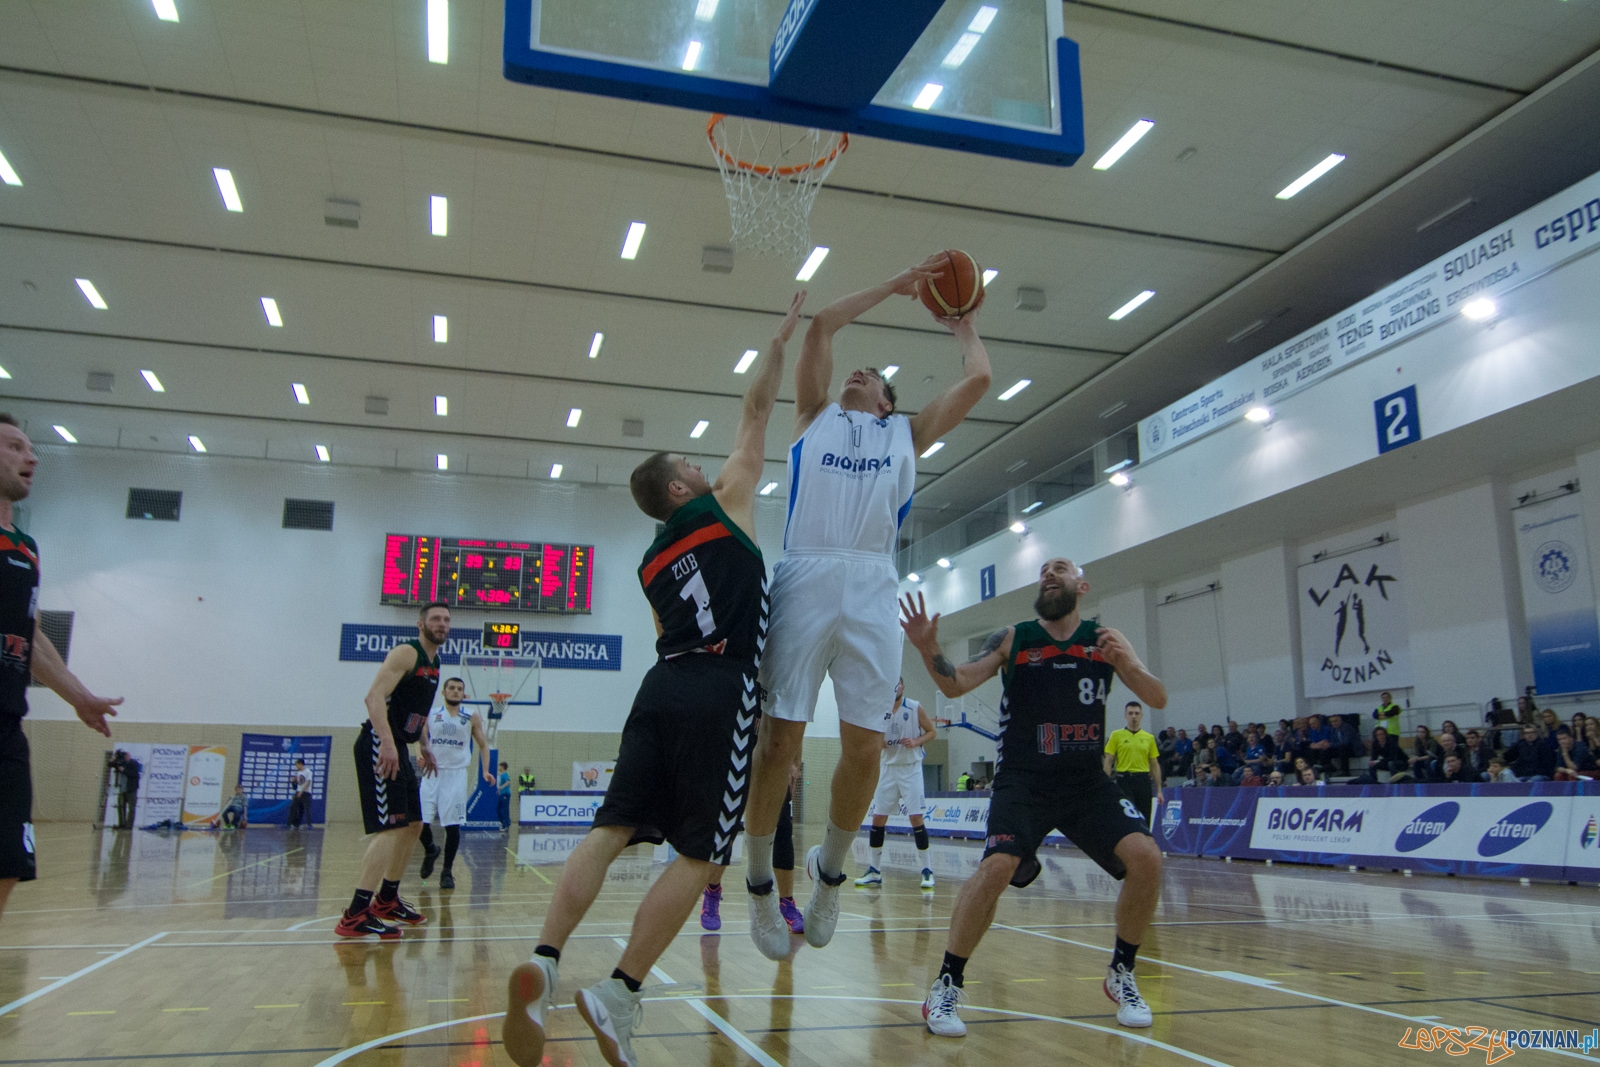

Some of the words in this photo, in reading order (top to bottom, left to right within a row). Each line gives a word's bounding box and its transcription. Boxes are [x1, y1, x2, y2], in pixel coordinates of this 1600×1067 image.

[1443, 228, 1514, 282] SQUASH
[1379, 297, 1440, 341] BOWLING
[1337, 319, 1374, 349] TENIS
[1261, 352, 1284, 372] HALA
[1284, 327, 1330, 359] SPORTOWA
[1296, 354, 1332, 383] AEROBIK
[1171, 402, 1200, 423] Centrum
[1200, 389, 1224, 409] Sportu
[1172, 413, 1210, 440] Politechniki
[1384, 396, 1409, 445] 2
[671, 552, 698, 581] ZUB
[982, 570, 991, 596] 1
[497, 634, 511, 647] 10
[1320, 648, 1393, 684] POZNAŃ
[442, 722, 456, 736] 10
[1060, 723, 1101, 741] PEC
[431, 738, 464, 747] BIOFARM
[1119, 798, 1146, 821] 8
[1189, 817, 1247, 828] www.basket.poznan.pl
[1267, 807, 1365, 833] BIOFARM
[1293, 834, 1328, 842] PRODUCENT
[1405, 818, 1446, 835] atrem
[1489, 820, 1537, 838] atrem
